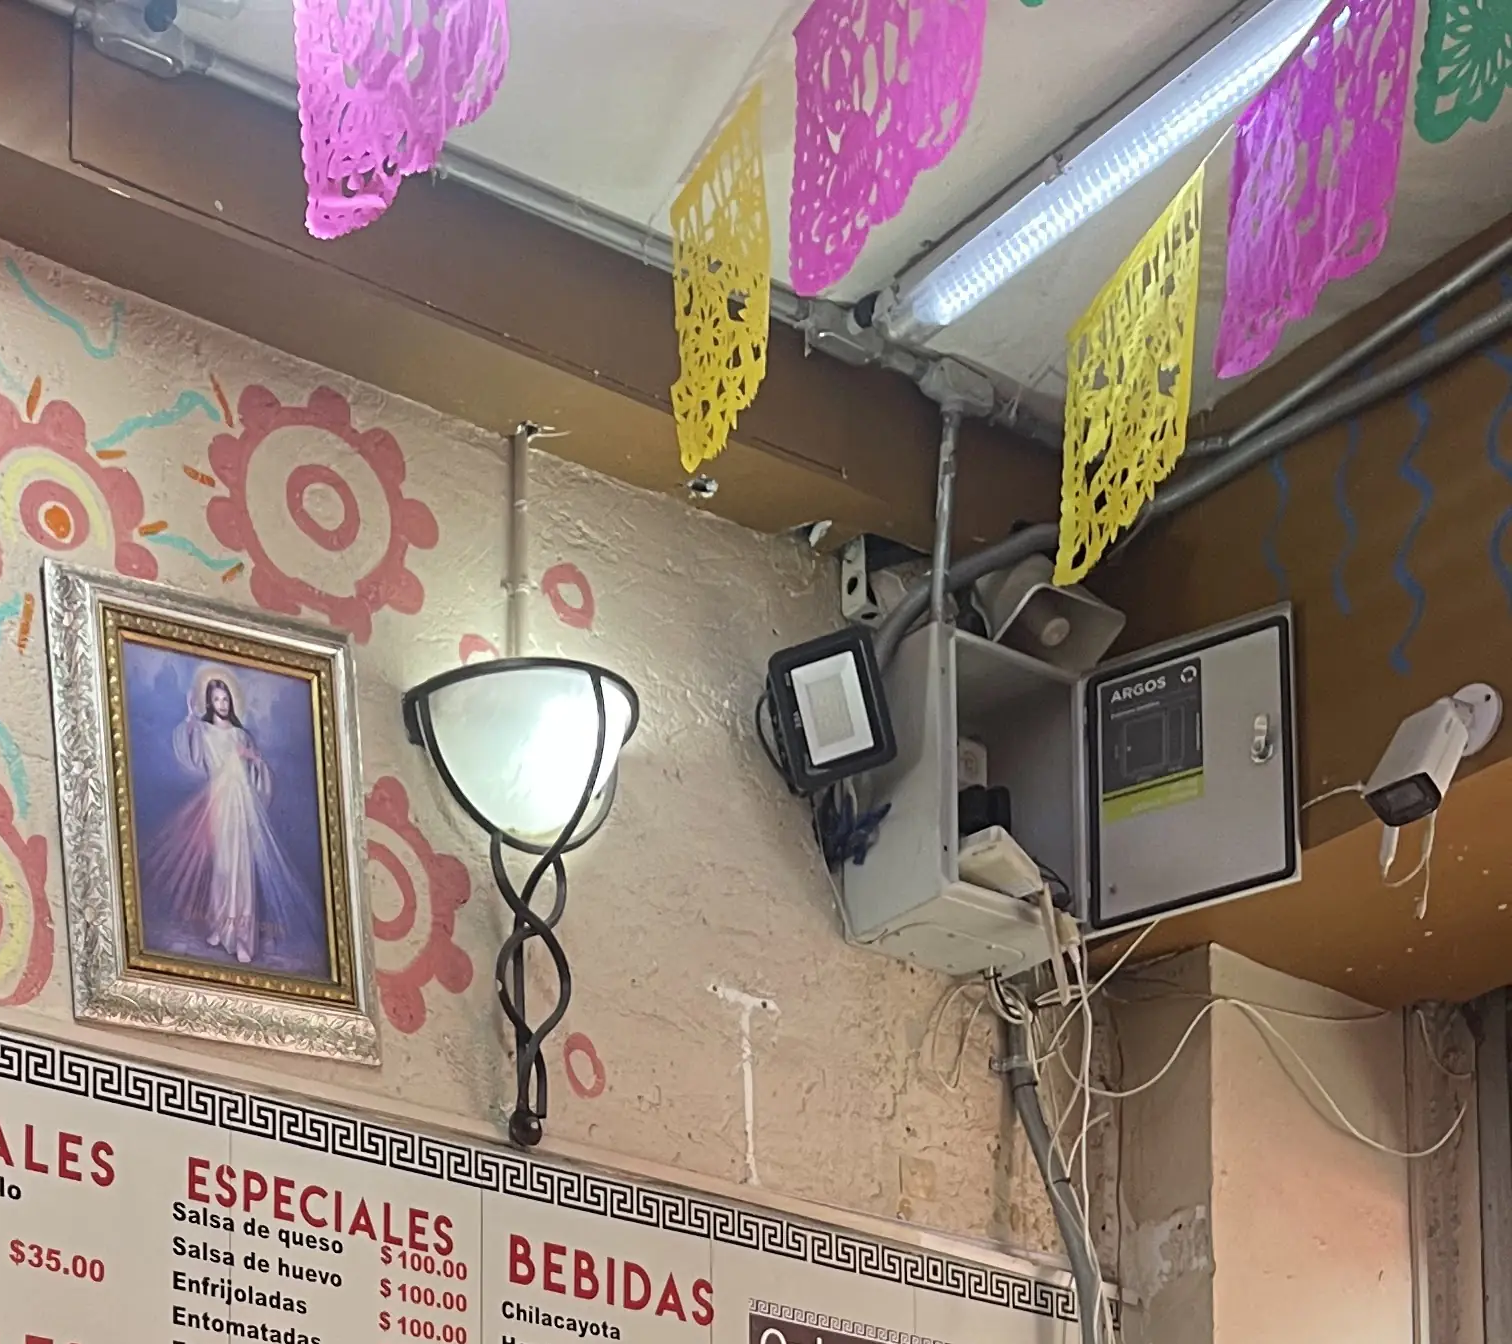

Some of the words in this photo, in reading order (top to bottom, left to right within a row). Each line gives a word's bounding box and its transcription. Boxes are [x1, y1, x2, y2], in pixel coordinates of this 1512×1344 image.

[1110, 676, 1166, 703] ARGOS
[172, 1201, 235, 1232] Salsa
[243, 1217, 270, 1239] de
[278, 1228, 344, 1254] queso
[188, 1156, 454, 1256] ESPECIALES
[9, 1238, 105, 1283] $35.00
[172, 1236, 235, 1267] Salsa
[243, 1252, 270, 1274] de
[278, 1258, 342, 1288] huevo
[509, 1233, 714, 1326] BEBIDAS
[172, 1270, 308, 1315] Enfrijoladas
[502, 1300, 621, 1340] Chilacayota
